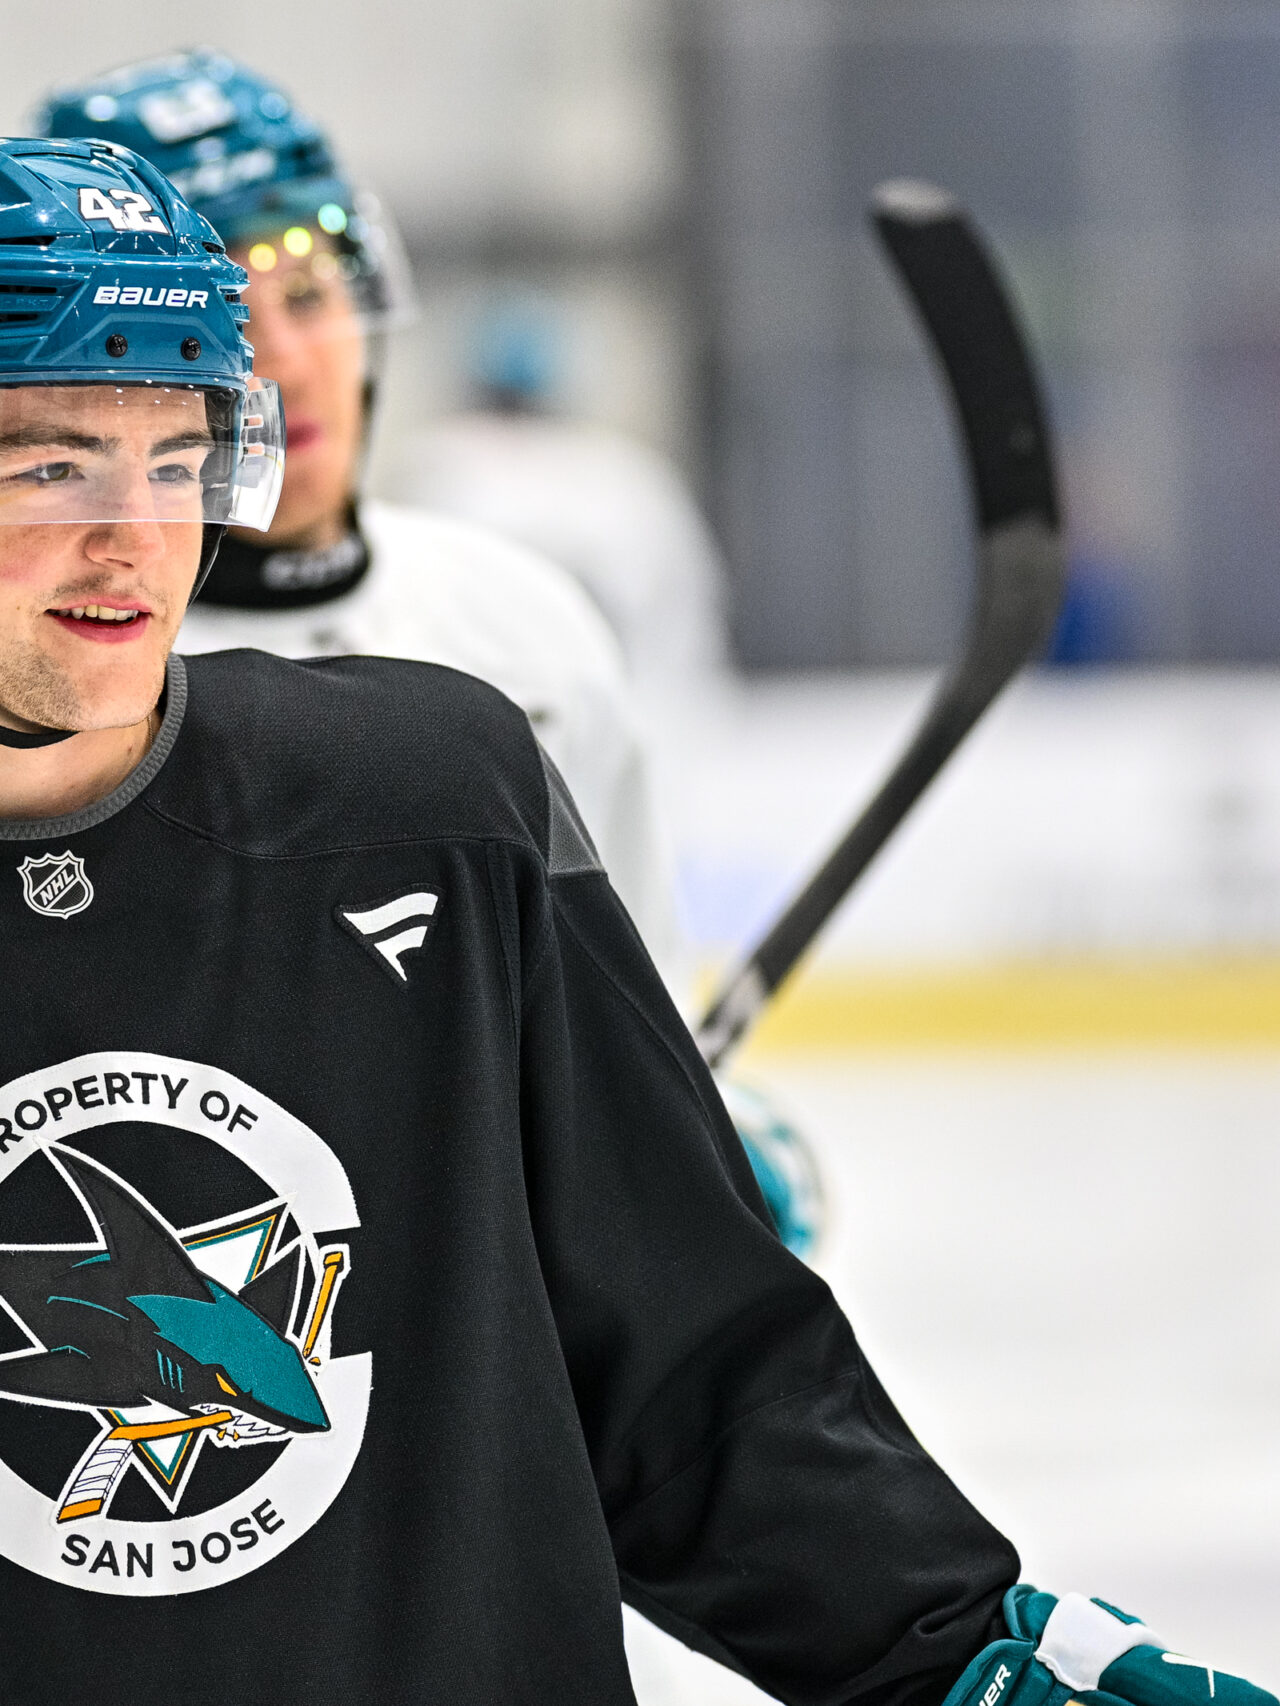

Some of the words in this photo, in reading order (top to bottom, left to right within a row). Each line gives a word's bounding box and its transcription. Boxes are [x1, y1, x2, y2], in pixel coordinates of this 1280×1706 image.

[78, 187, 171, 236] 42
[93, 286, 209, 309] BAUER
[40, 868, 75, 906] NHL
[199, 1090, 258, 1133] OF
[61, 1534, 153, 1577] SAN
[172, 1498, 285, 1572] JOSE
